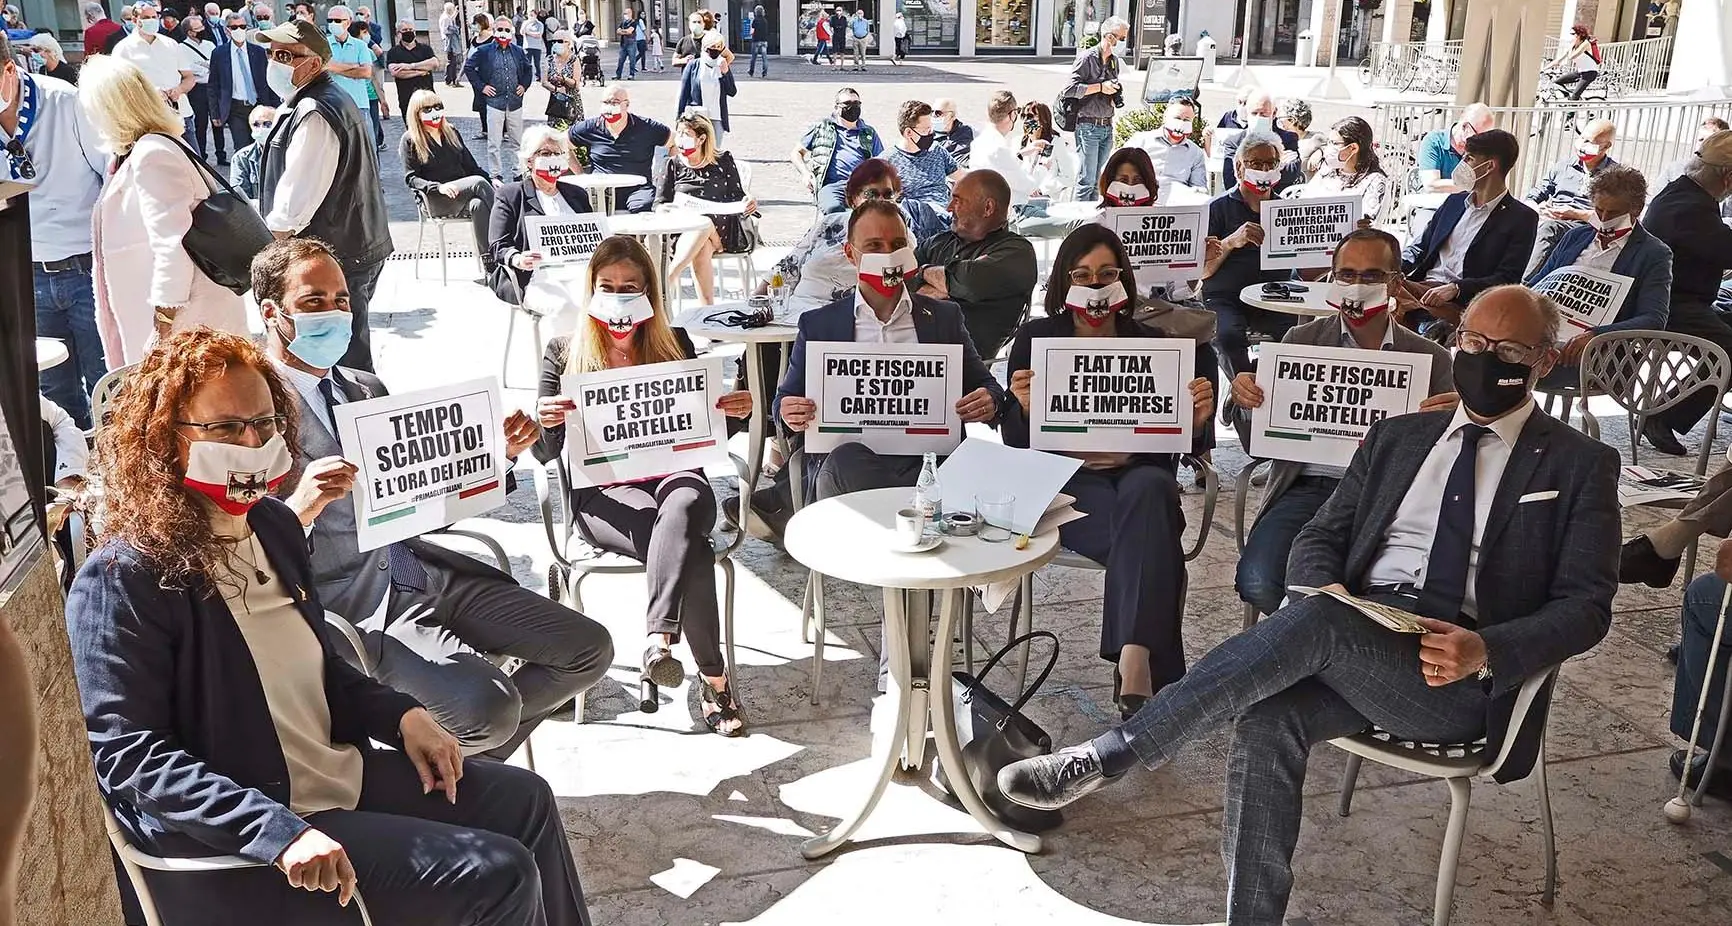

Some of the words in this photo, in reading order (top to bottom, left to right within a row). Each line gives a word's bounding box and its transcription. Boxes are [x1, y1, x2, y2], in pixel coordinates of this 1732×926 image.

[1278, 208, 1302, 217] AIUTI
[1305, 206, 1325, 216] VERI
[1328, 205, 1345, 214] PER
[541, 223, 598, 235] BUROCRAZIA
[1142, 216, 1175, 229] STOP
[1275, 214, 1348, 227] COMMERCIANTI
[1122, 229, 1191, 244] SANATORIA
[1288, 224, 1335, 235] ARTIGIANI
[541, 235, 562, 246] ZERO
[565, 235, 570, 244] E
[571, 233, 603, 243] POTERI
[1280, 237, 1285, 245] E
[1287, 234, 1324, 244] PARTITE
[1327, 233, 1342, 242] IVA
[550, 247, 560, 256] AI
[1558, 283, 1567, 292] E
[1566, 284, 1610, 308] POTERI
[827, 359, 870, 376] PACE
[875, 360, 944, 378] FISCALE
[1074, 356, 1114, 373] FLAT
[1118, 356, 1152, 373] TAX
[1278, 362, 1326, 382] PACE
[1331, 366, 1408, 389] FISCALE
[585, 385, 630, 406] PACE
[634, 375, 704, 400] FISCALE
[856, 379, 864, 395] E
[869, 379, 914, 396] STOP
[1070, 376, 1078, 392] E
[1083, 376, 1156, 393] FIDUCIA
[1308, 384, 1318, 401] E
[1322, 386, 1372, 405] STOP
[616, 405, 626, 420] E
[630, 397, 676, 419] STOP
[840, 397, 929, 415] CARTELLE!
[1050, 395, 1089, 412] ALLE
[1094, 396, 1173, 414] IMPRESE
[390, 403, 463, 440] TEMPO
[603, 413, 692, 442] CARTELLE!
[376, 424, 484, 472] SCADUTO!
[374, 474, 383, 499] È
[386, 474, 427, 496] L'ORA
[432, 463, 453, 484] DEI
[457, 453, 491, 477] FATTI
